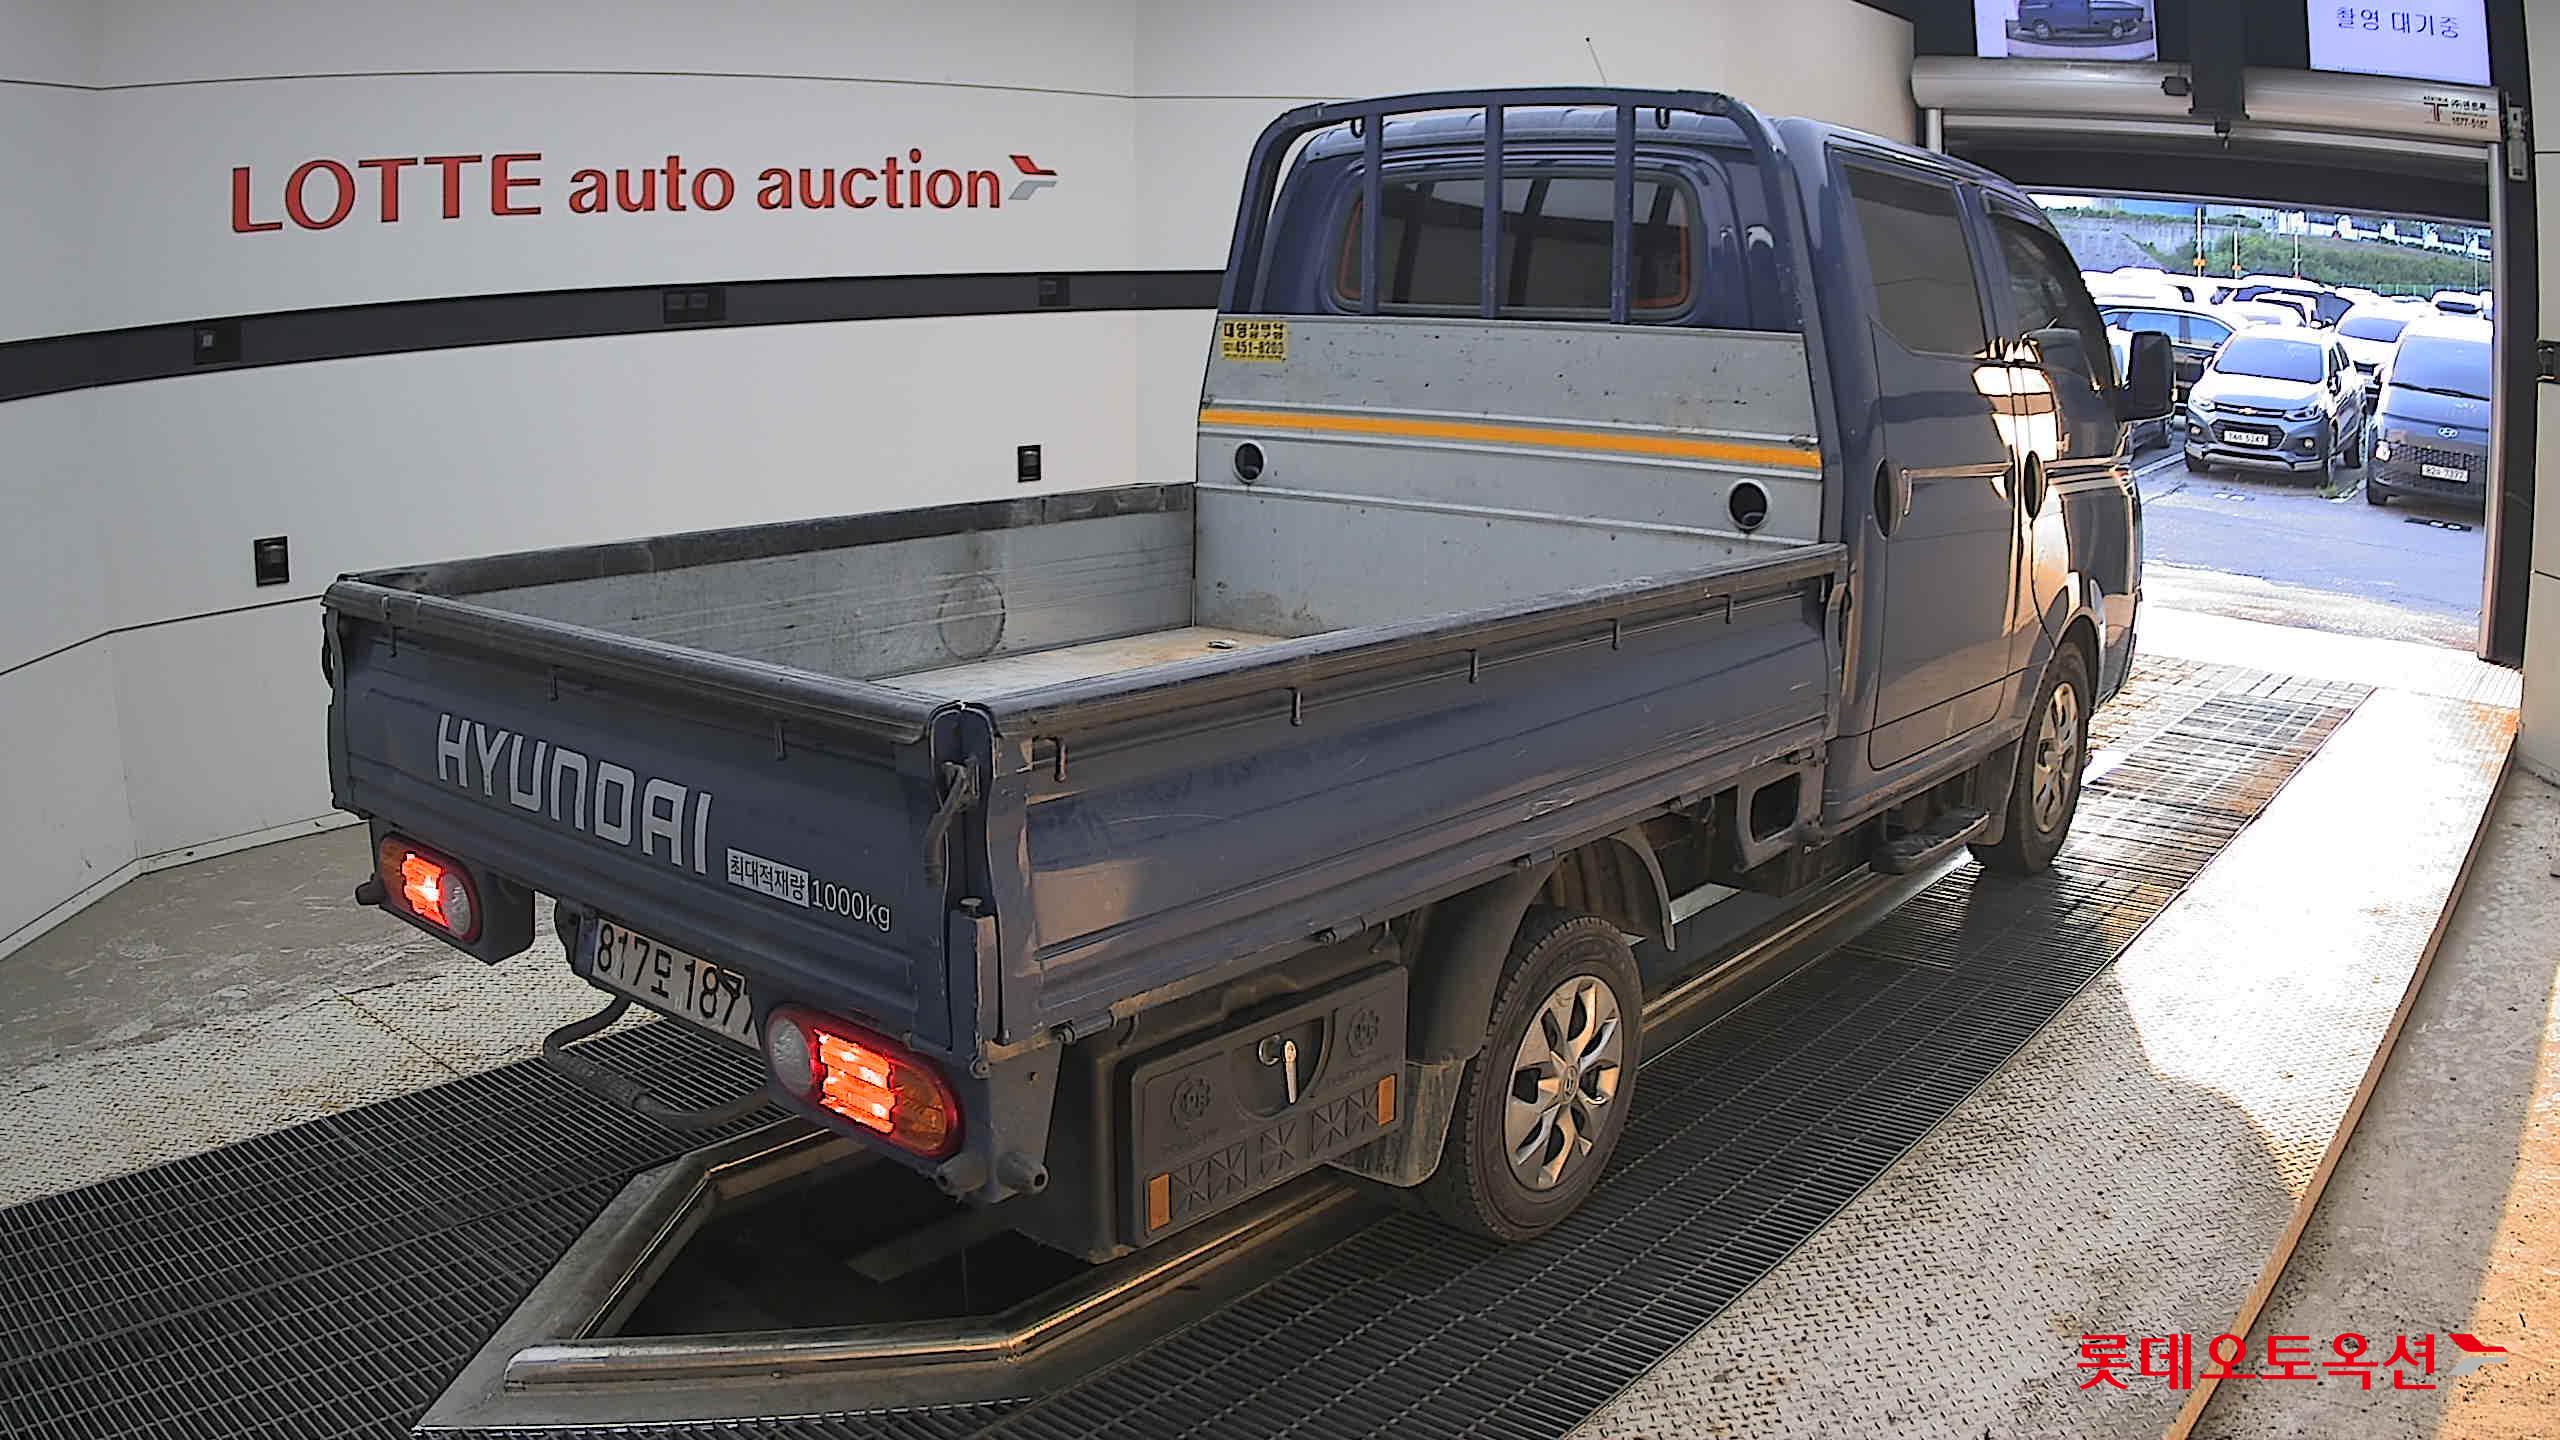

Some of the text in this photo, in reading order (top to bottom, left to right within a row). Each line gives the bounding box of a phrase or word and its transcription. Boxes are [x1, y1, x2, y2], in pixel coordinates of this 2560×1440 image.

[2337, 6, 2461, 39] 촬영 대기중
[231, 148, 1001, 234] LOTTE auto auction
[437, 712, 713, 875] HYUNDAI
[729, 852, 892, 932] 최대적재량 1000kg
